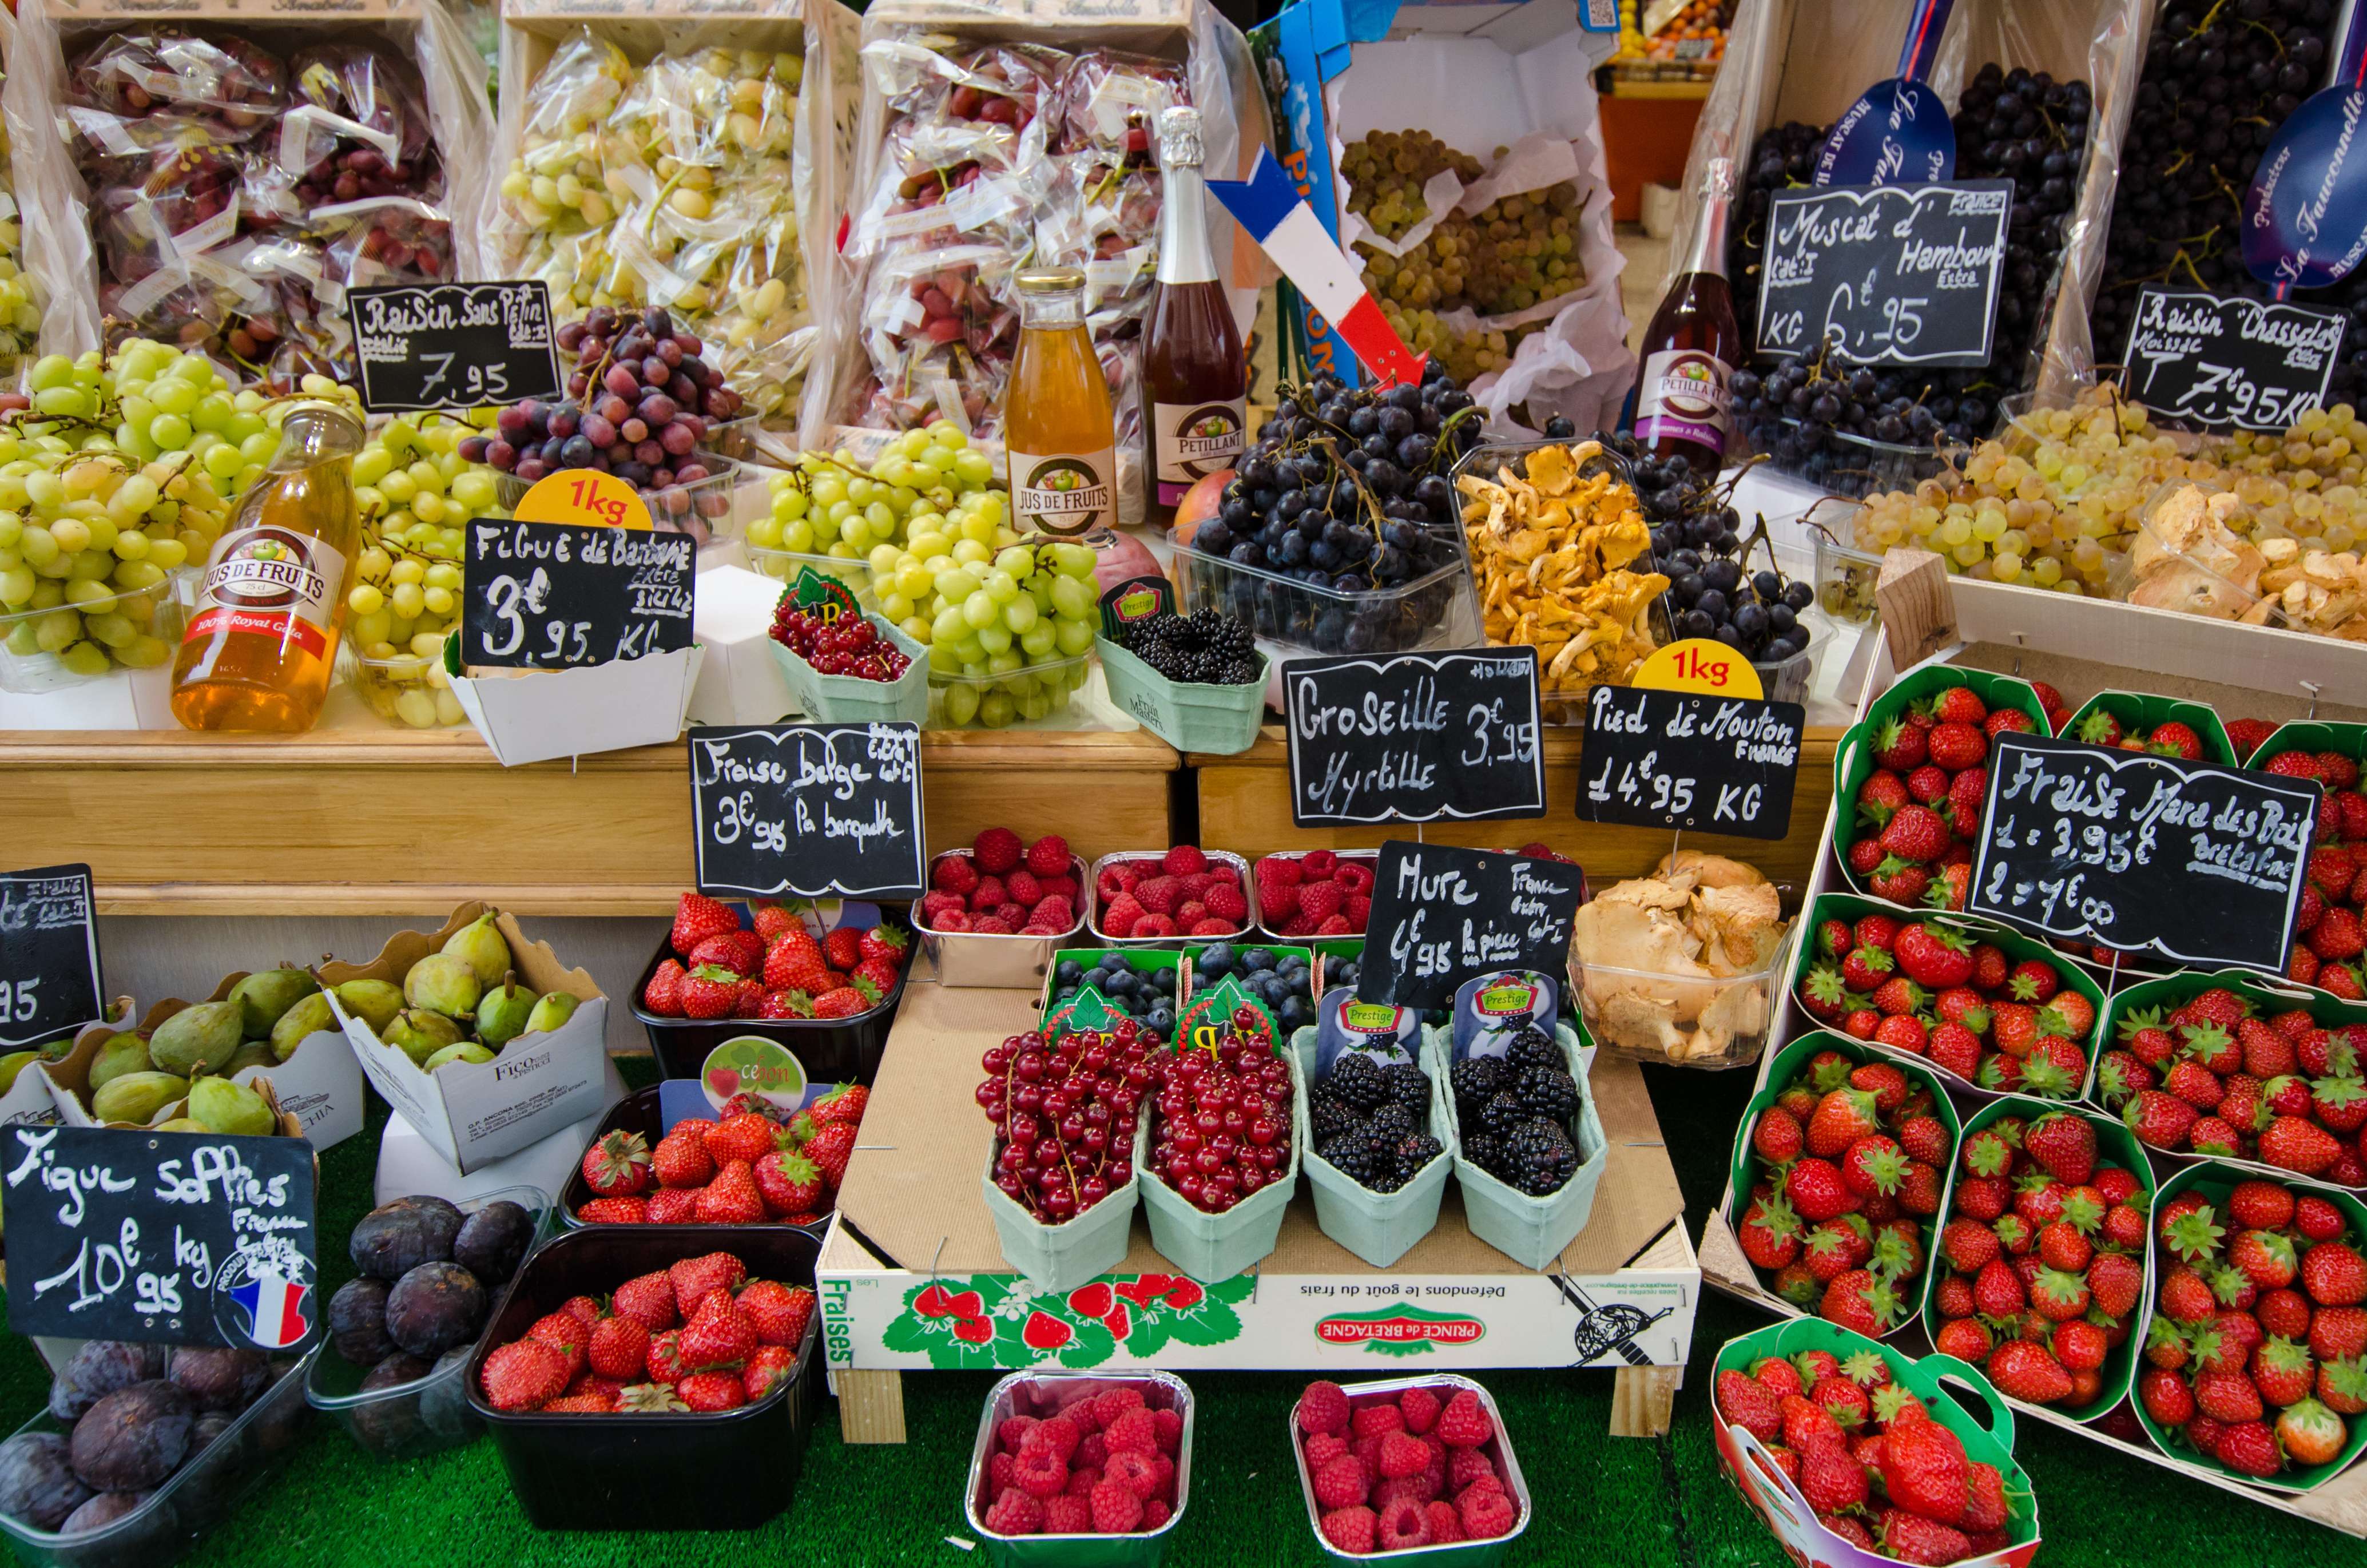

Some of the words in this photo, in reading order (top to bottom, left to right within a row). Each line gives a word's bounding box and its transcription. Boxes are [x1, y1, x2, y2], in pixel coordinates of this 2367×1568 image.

[2297, 91, 2365, 243] Fauconnette
[1779, 204, 1879, 257] Muscat
[1179, 432, 1240, 453] PETILLANT
[570, 478, 628, 525] 1kg
[1020, 491, 1040, 509] JUS
[1045, 495, 1060, 509] DE
[1064, 487, 1108, 509] FRUITS
[201, 565, 230, 593] JUS
[233, 563, 255, 577] DE
[257, 562, 324, 599] FRUITS
[1123, 597, 1154, 613] Prestige
[197, 616, 227, 631] 100%
[231, 615, 269, 628] Royal
[1672, 647, 1730, 687] 1kg
[704, 741, 787, 785] Fraise
[2003, 753, 2126, 819] Fraise
[1713, 783, 1761, 821] KG
[1486, 993, 1527, 1006] Prestige
[1350, 1009, 1392, 1022] Prestige
[494, 1057, 533, 1082] Fico
[484, 1106, 513, 1122] ANCONA
[856, 1279, 879, 1288] Les
[1300, 1285, 1336, 1296] frais
[1341, 1285, 1360, 1297] du
[1365, 1284, 1400, 1297] goût
[1405, 1285, 1420, 1297] le
[1425, 1285, 1506, 1297] Défendons
[823, 1280, 855, 1362] Fraises
[1323, 1324, 1403, 1337] BRETAGNE
[1406, 1325, 1419, 1335] de
[1423, 1324, 1476, 1337] PRINCE
